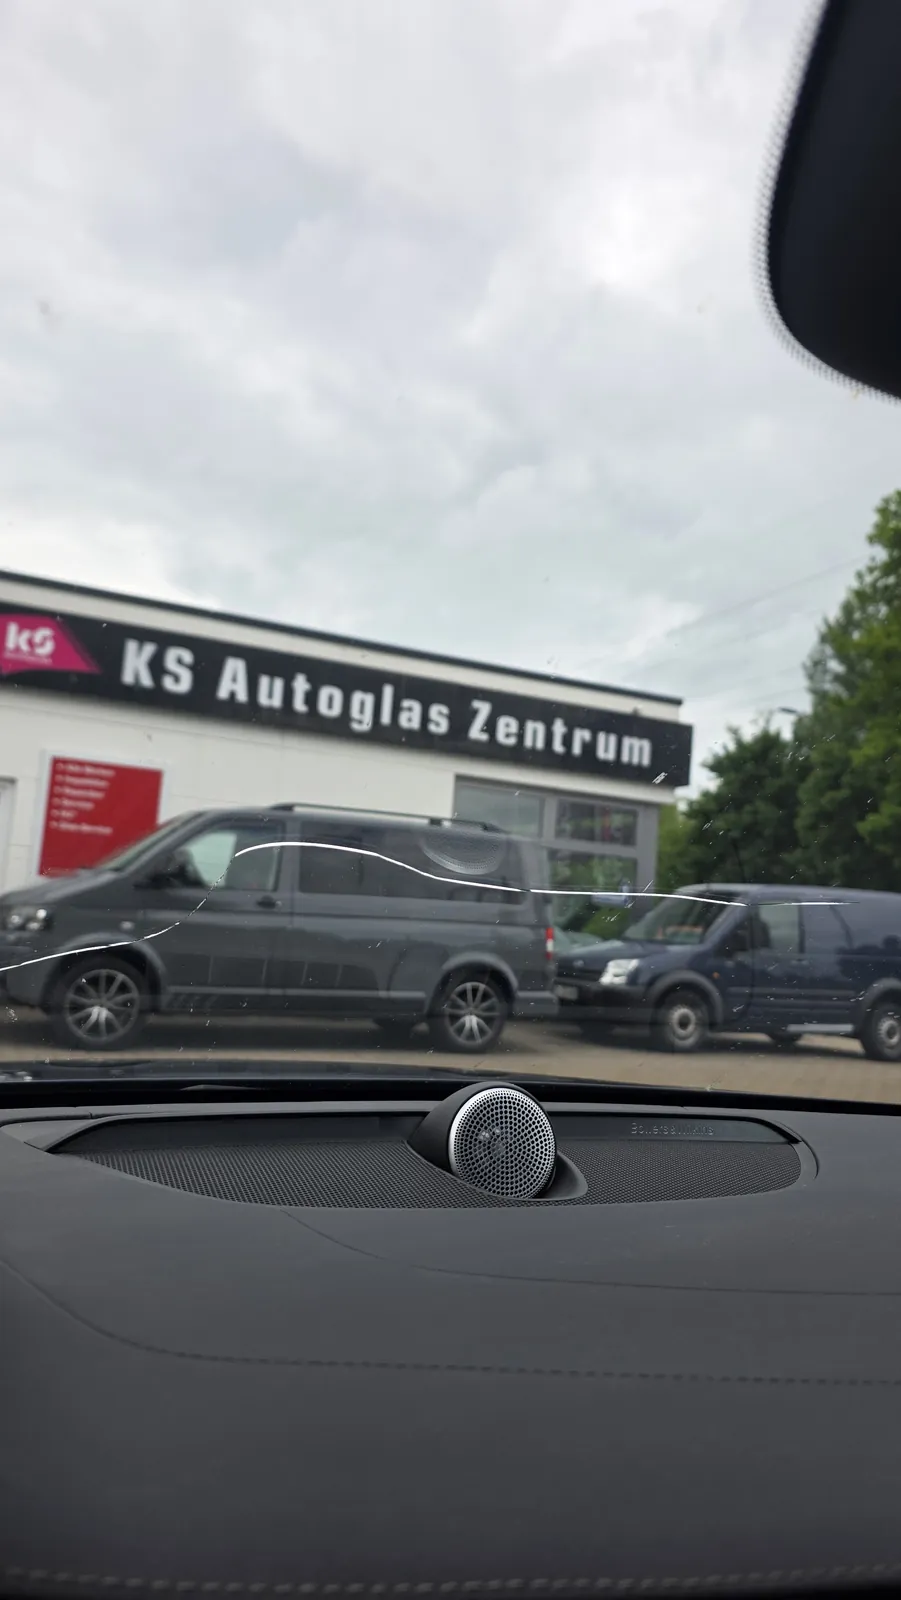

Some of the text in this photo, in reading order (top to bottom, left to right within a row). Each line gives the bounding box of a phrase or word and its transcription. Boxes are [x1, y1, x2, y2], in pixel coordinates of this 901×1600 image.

[120, 638, 653, 769] KS Autoglas Zentrum
